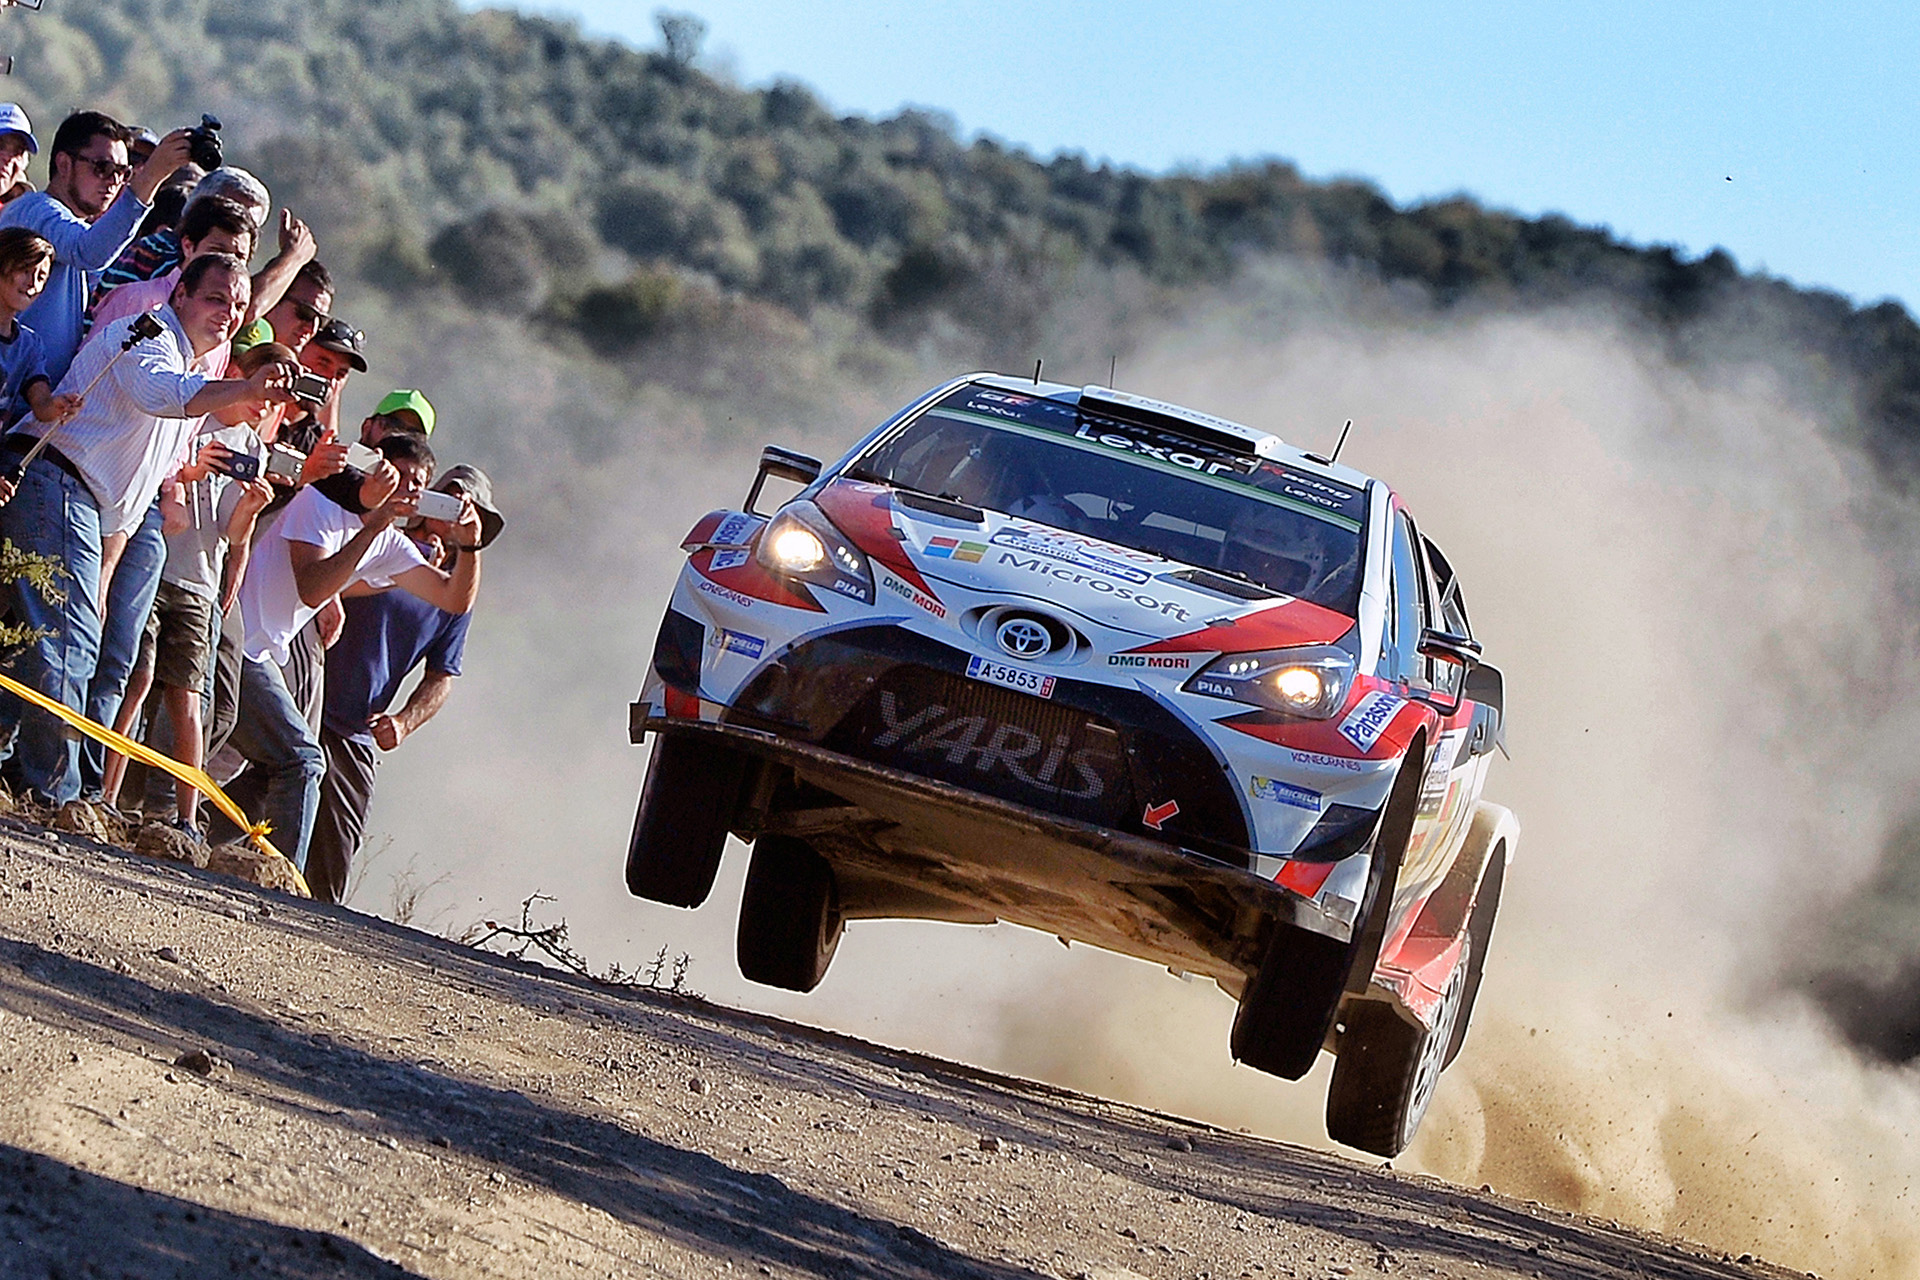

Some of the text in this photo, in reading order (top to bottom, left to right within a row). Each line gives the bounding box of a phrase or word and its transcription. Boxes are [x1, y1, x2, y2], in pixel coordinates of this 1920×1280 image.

[1075, 422, 1234, 475] Lexar
[834, 579, 867, 600] PIAA
[883, 576, 947, 618] DMG MORI
[997, 551, 1192, 624] Microsoft
[1107, 655, 1191, 669] DMG MORI
[1197, 680, 1235, 697] PIAA
[1291, 752, 1361, 772] KONECRANES
